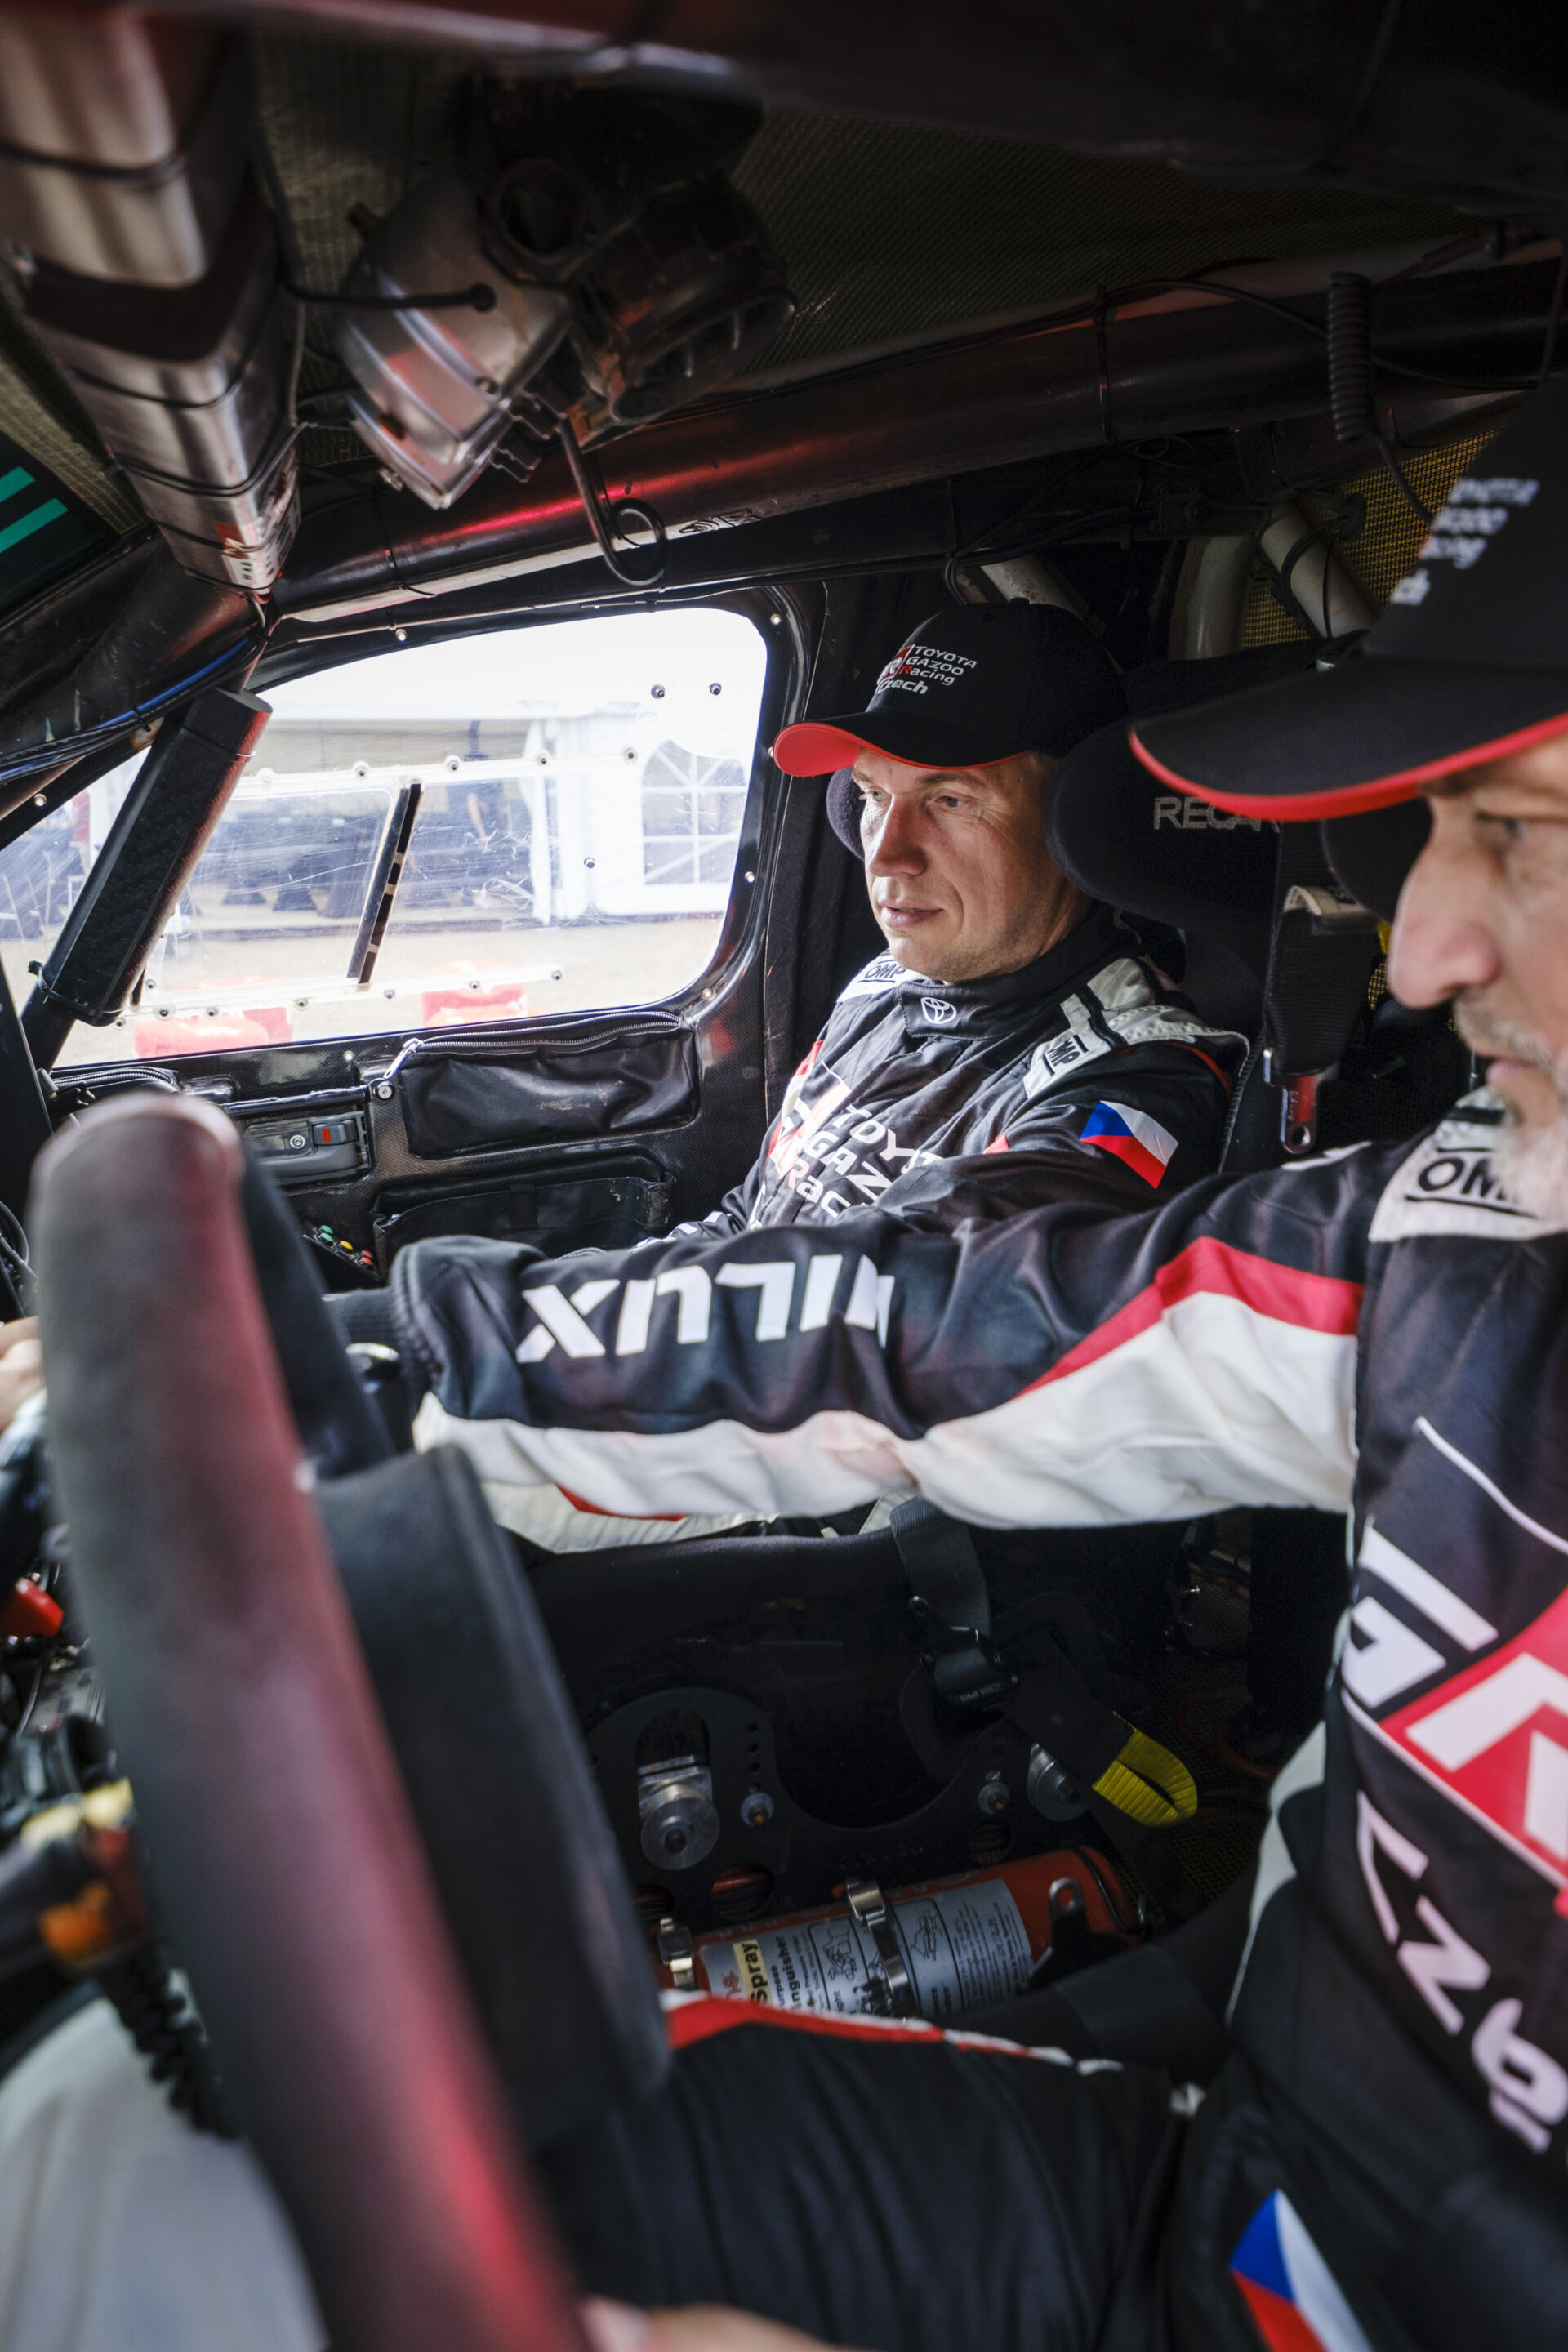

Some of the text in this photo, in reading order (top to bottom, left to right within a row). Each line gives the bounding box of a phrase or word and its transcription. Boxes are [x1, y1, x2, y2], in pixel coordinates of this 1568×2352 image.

[906, 656, 964, 675] GAZOO
[914, 645, 978, 669] TOYOTA
[898, 665, 956, 686] Racing
[864, 964, 906, 978] OMP
[803, 1130, 893, 1200] GAZ
[742, 1944, 768, 2002] Spray
[770, 1964, 785, 2006] urpose
